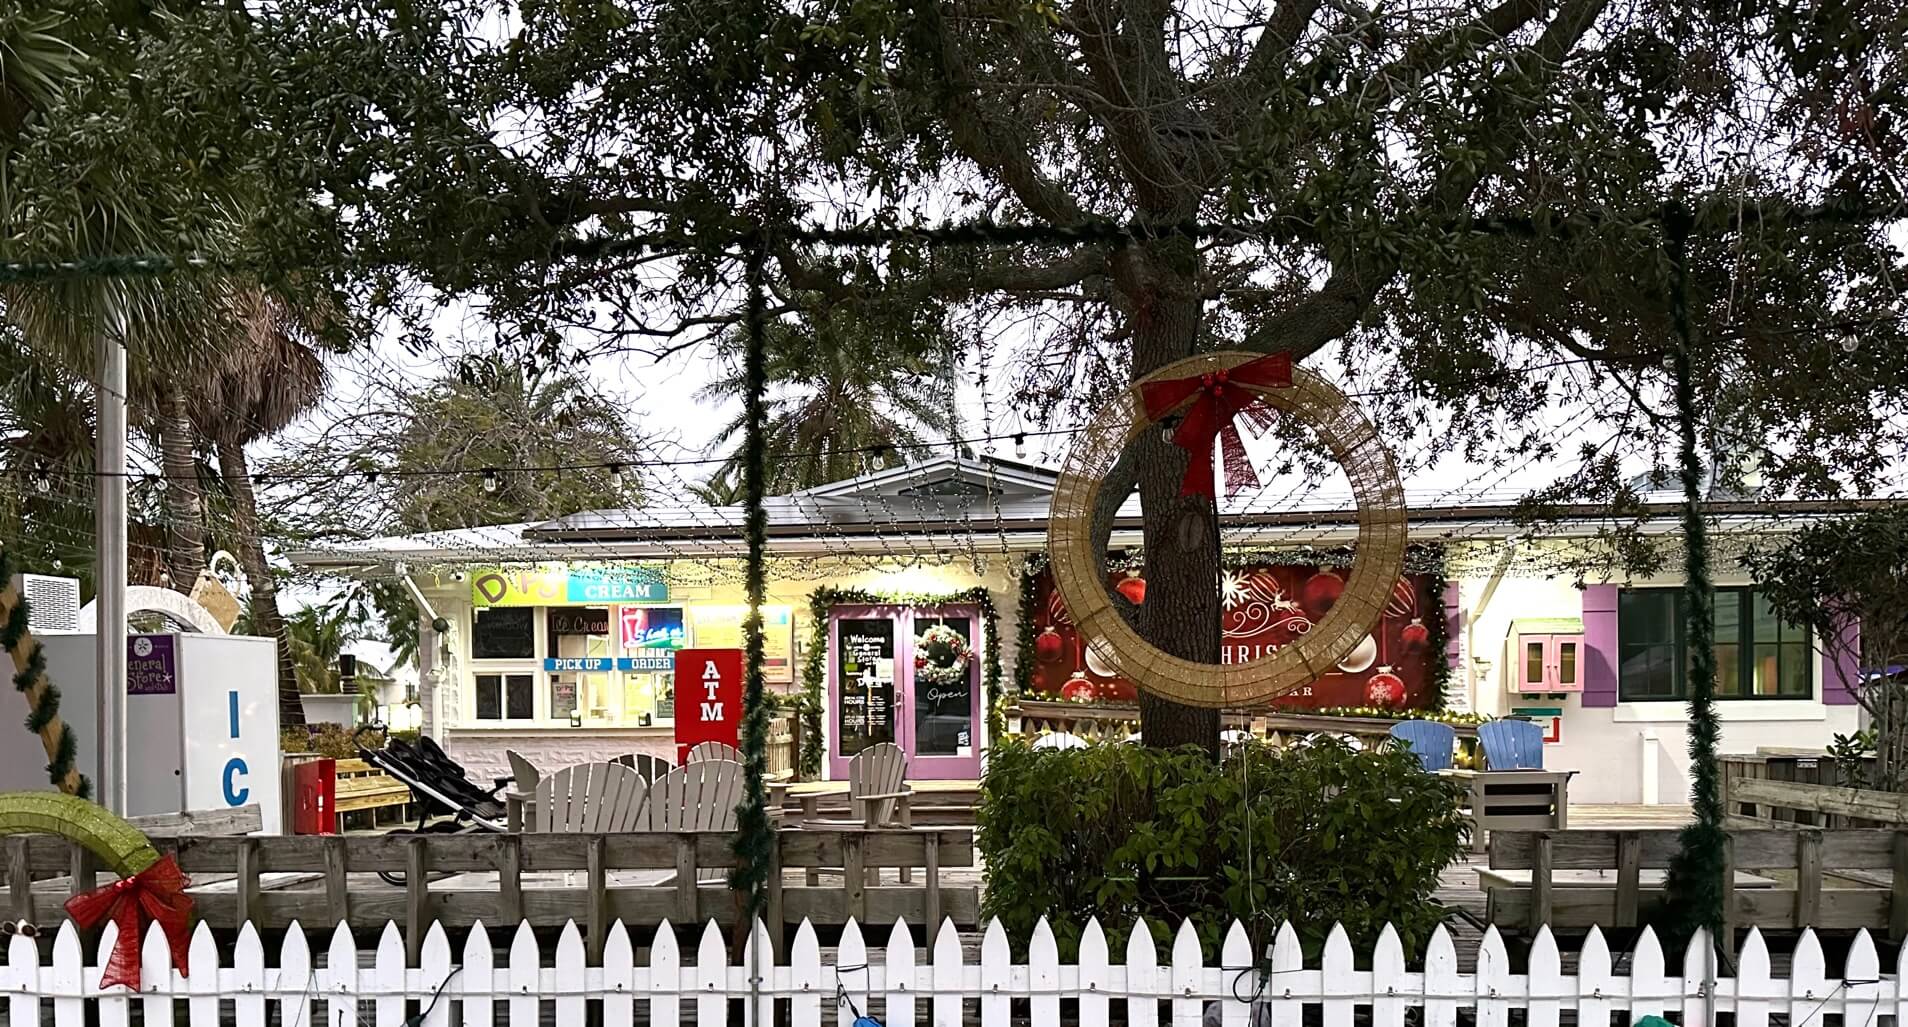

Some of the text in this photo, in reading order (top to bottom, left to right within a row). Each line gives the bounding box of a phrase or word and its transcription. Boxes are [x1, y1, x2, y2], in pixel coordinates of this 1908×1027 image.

[585, 584, 651, 599] CREAM
[850, 634, 885, 643] Welcome
[127, 653, 166, 673] eneral
[555, 658, 602, 669] PICK UP
[631, 658, 671, 669] ORDER
[700, 660, 724, 721] ATM
[927, 688, 968, 707] Open
[223, 691, 249, 806] IC
